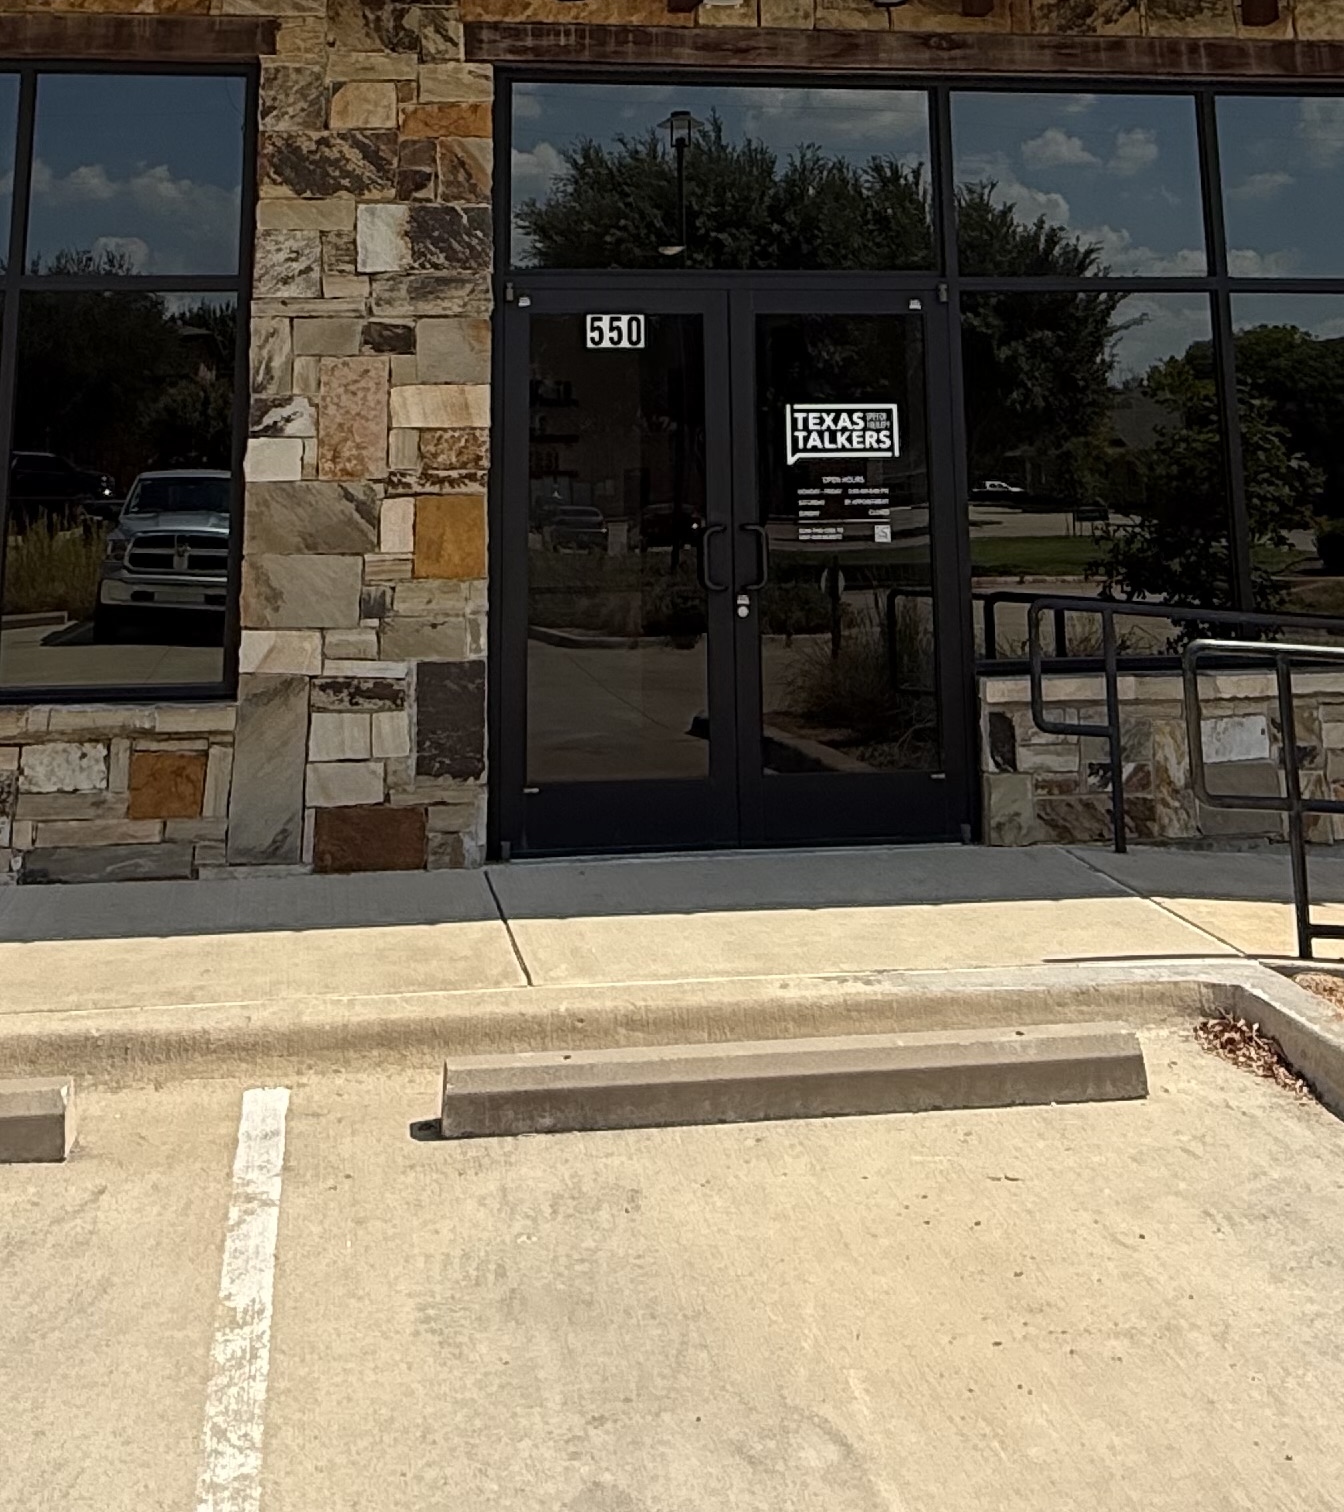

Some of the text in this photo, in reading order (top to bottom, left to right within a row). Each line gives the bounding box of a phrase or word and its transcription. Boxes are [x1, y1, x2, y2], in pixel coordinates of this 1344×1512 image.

[589, 316, 642, 347] 550
[793, 411, 865, 430] TEXAS
[793, 430, 892, 449] TALKERS
